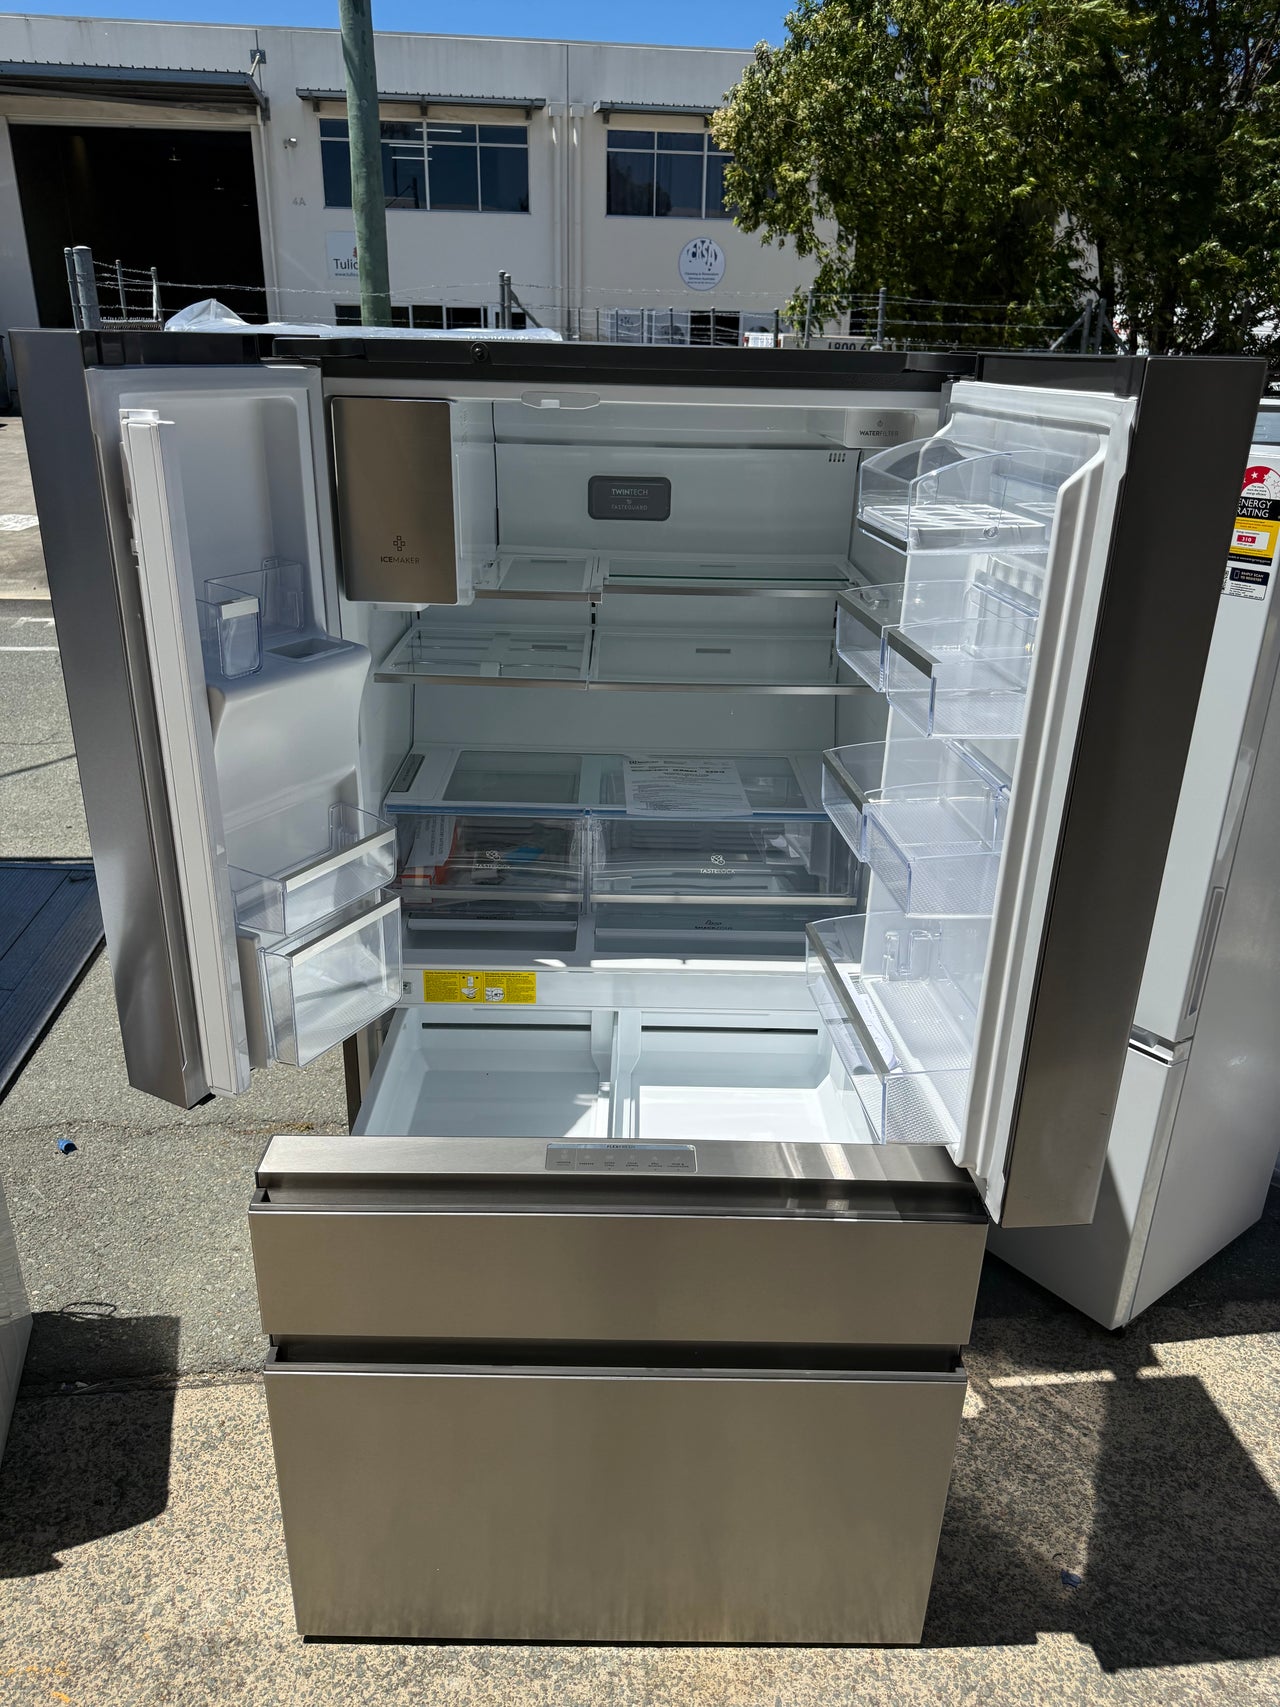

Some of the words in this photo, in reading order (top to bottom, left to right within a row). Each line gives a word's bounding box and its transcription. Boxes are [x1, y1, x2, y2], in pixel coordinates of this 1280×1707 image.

[292, 197, 306, 206] 4A
[611, 488, 648, 496] TWINTECH
[380, 556, 420, 564] ICEMAKER
